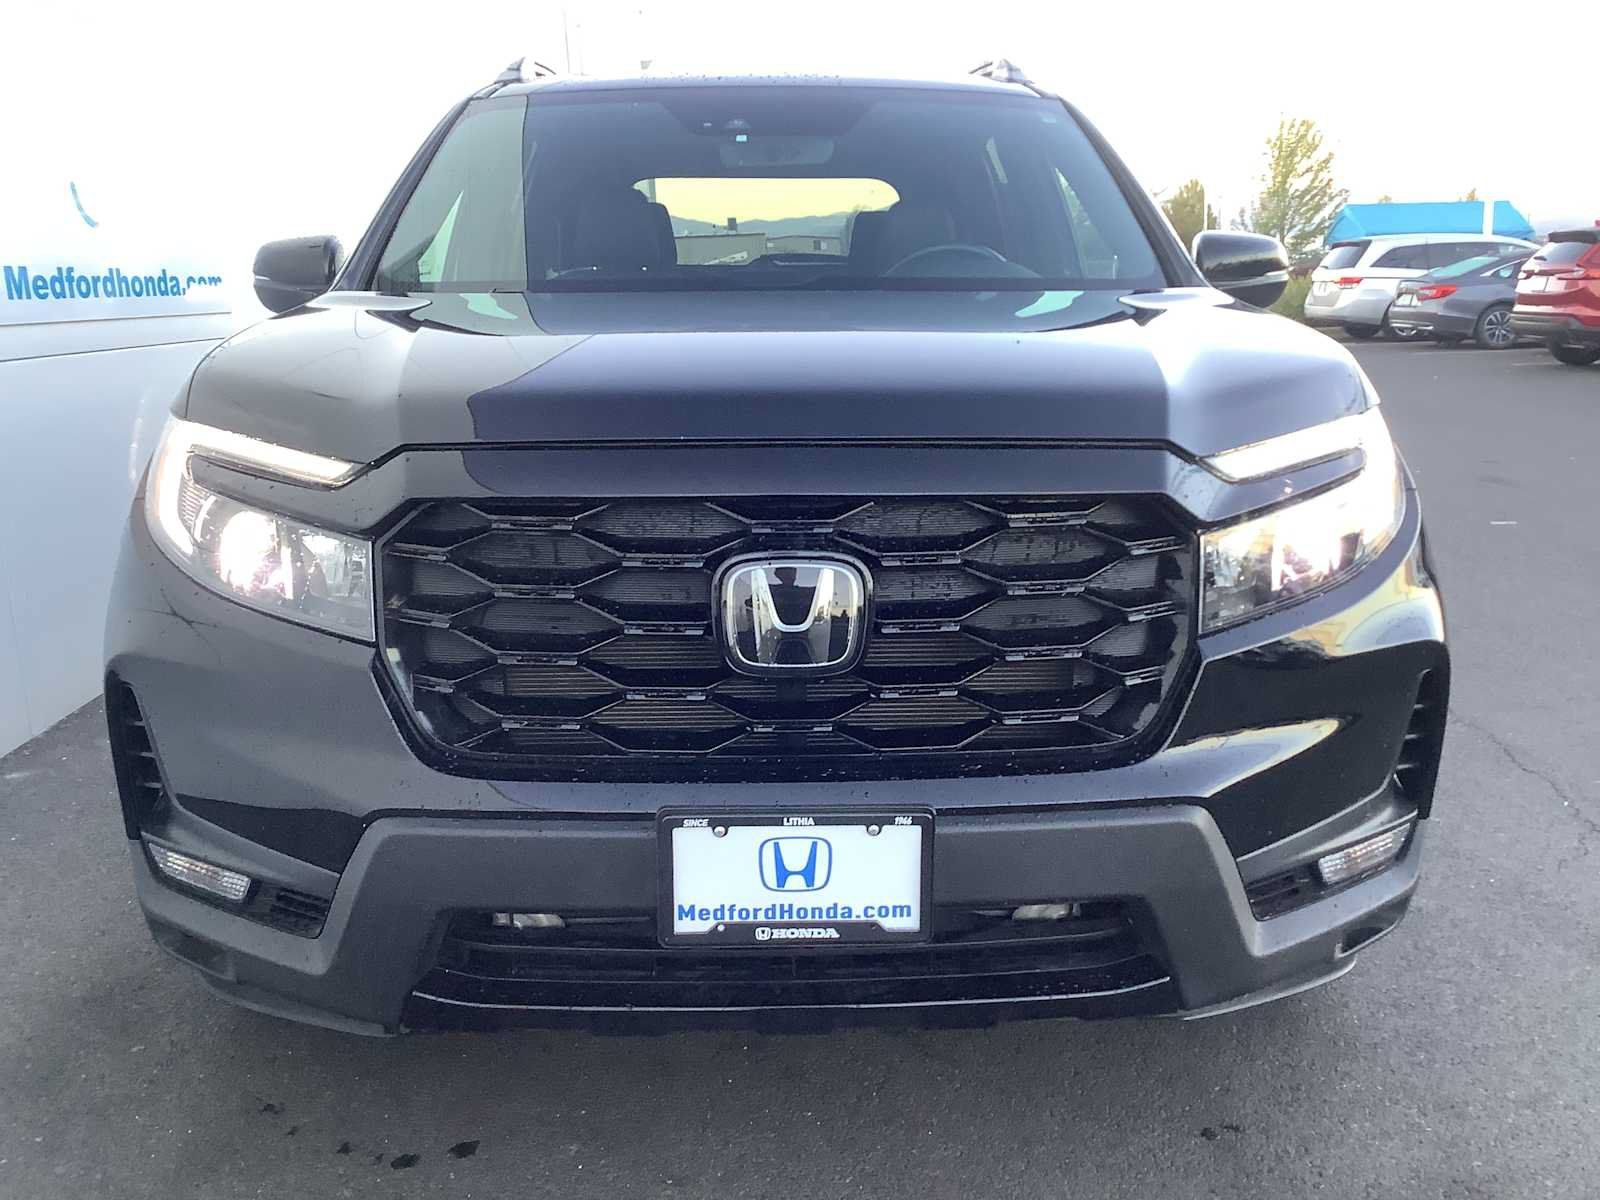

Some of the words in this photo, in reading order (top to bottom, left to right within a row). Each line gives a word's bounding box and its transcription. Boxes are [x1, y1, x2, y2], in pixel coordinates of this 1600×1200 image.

[682, 818, 709, 827] SINCE
[783, 817, 815, 826] LITHIA
[678, 903, 911, 920] MedfordHonda.com
[771, 928, 840, 939] HONDA
